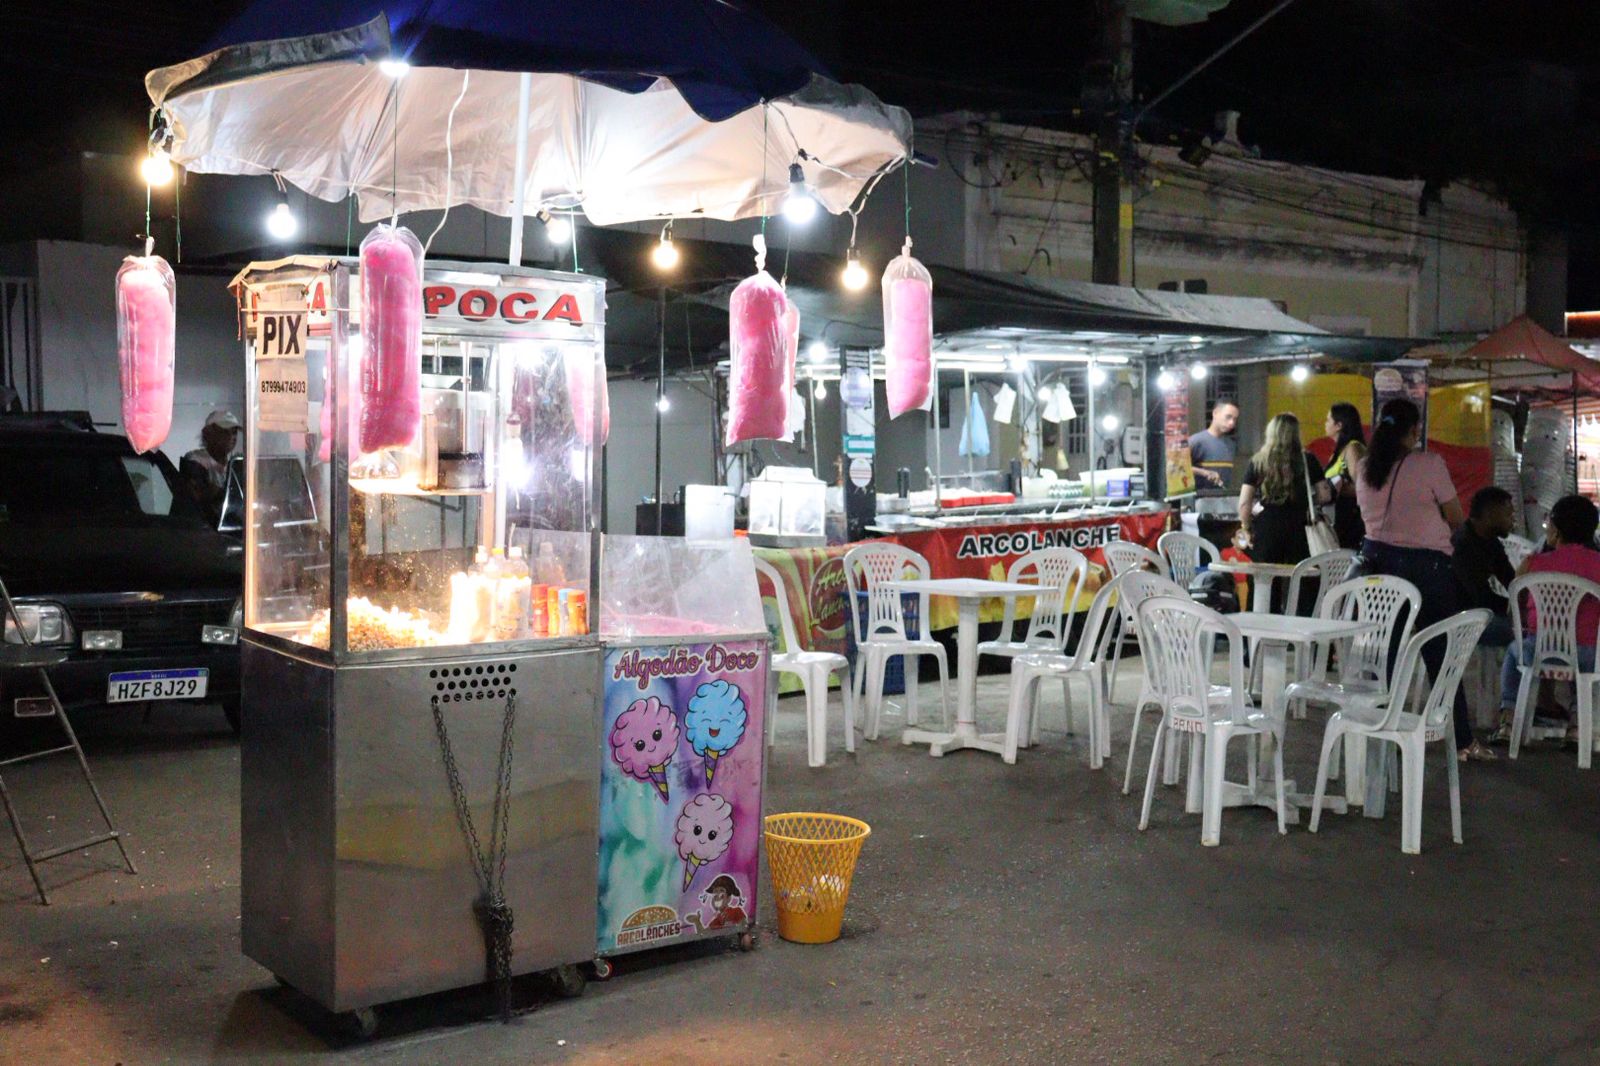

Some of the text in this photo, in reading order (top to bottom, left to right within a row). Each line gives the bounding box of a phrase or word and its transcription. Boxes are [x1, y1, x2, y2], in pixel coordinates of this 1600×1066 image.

[423, 286, 583, 327] POCA
[262, 315, 302, 355] PIX
[705, 643, 760, 673] Doce
[118, 680, 197, 699] HZF8J29
